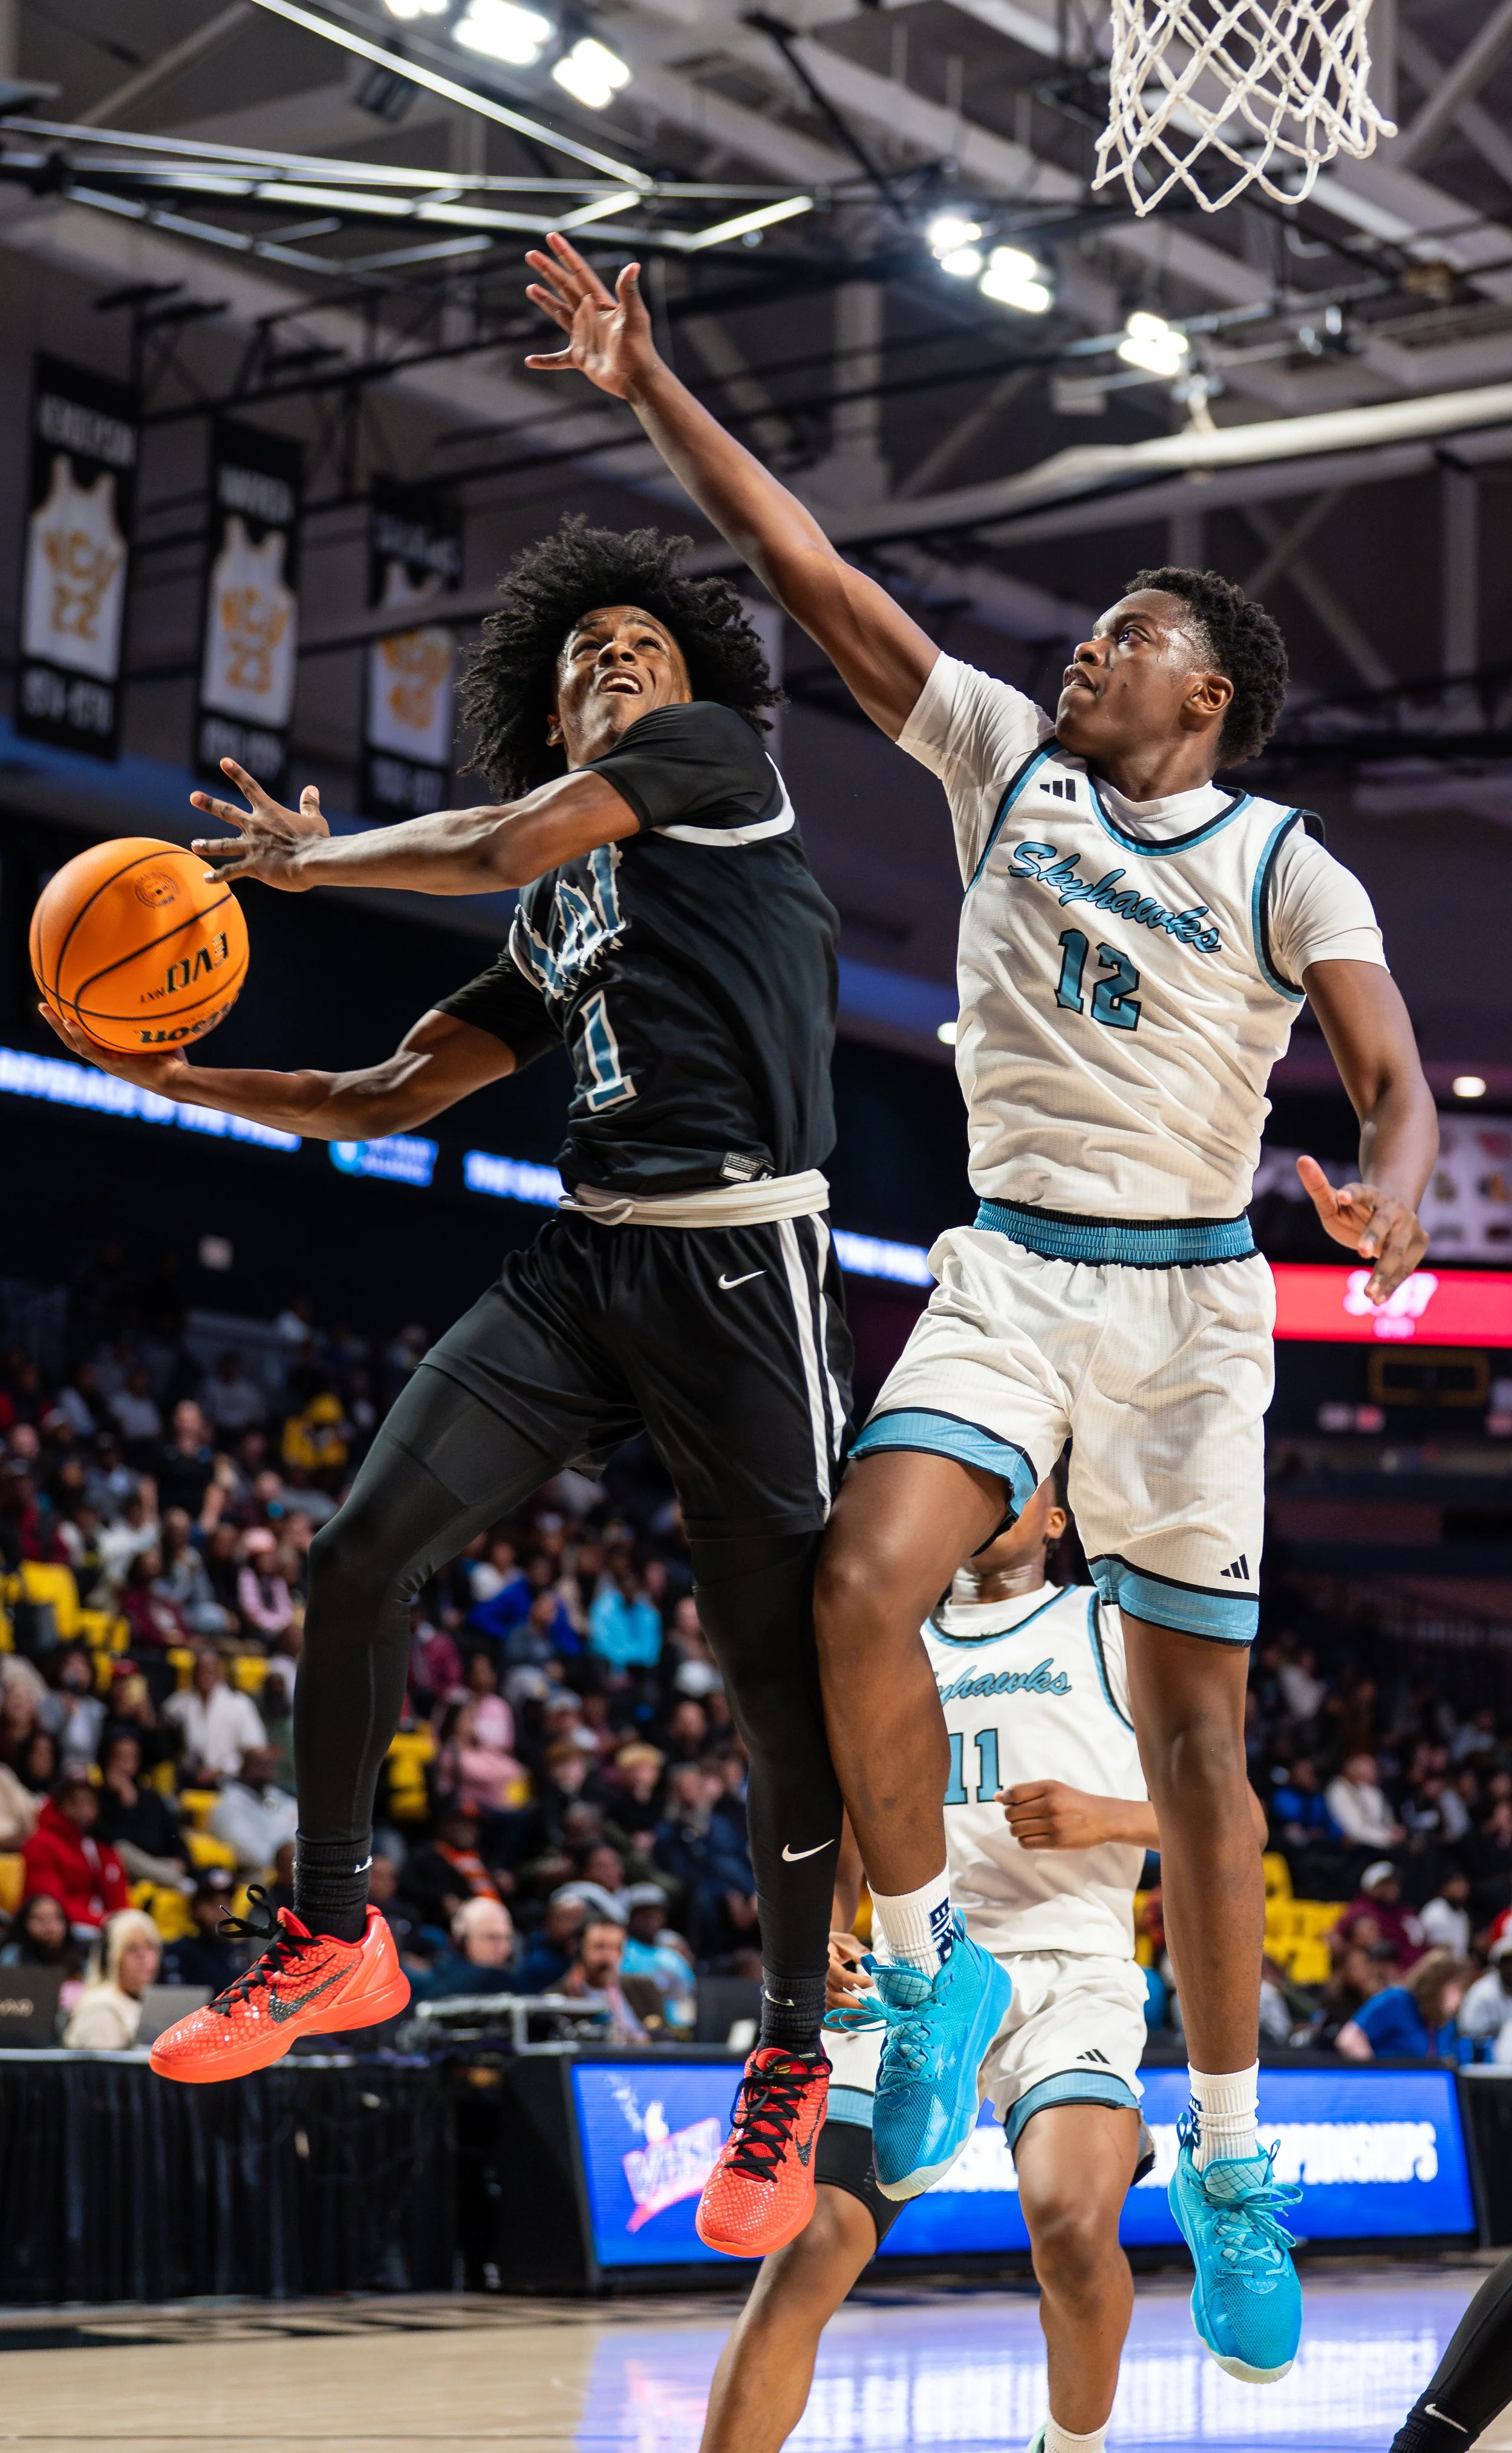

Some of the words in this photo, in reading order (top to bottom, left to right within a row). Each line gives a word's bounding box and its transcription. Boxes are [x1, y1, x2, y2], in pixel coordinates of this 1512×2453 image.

[1008, 841, 1221, 954] Skyhawks
[165, 929, 229, 995] EVO
[1054, 928, 1142, 1032] 12
[578, 989, 637, 1113] 1
[934, 1658, 1072, 1707] yhawks
[943, 1727, 1004, 1806] 11
